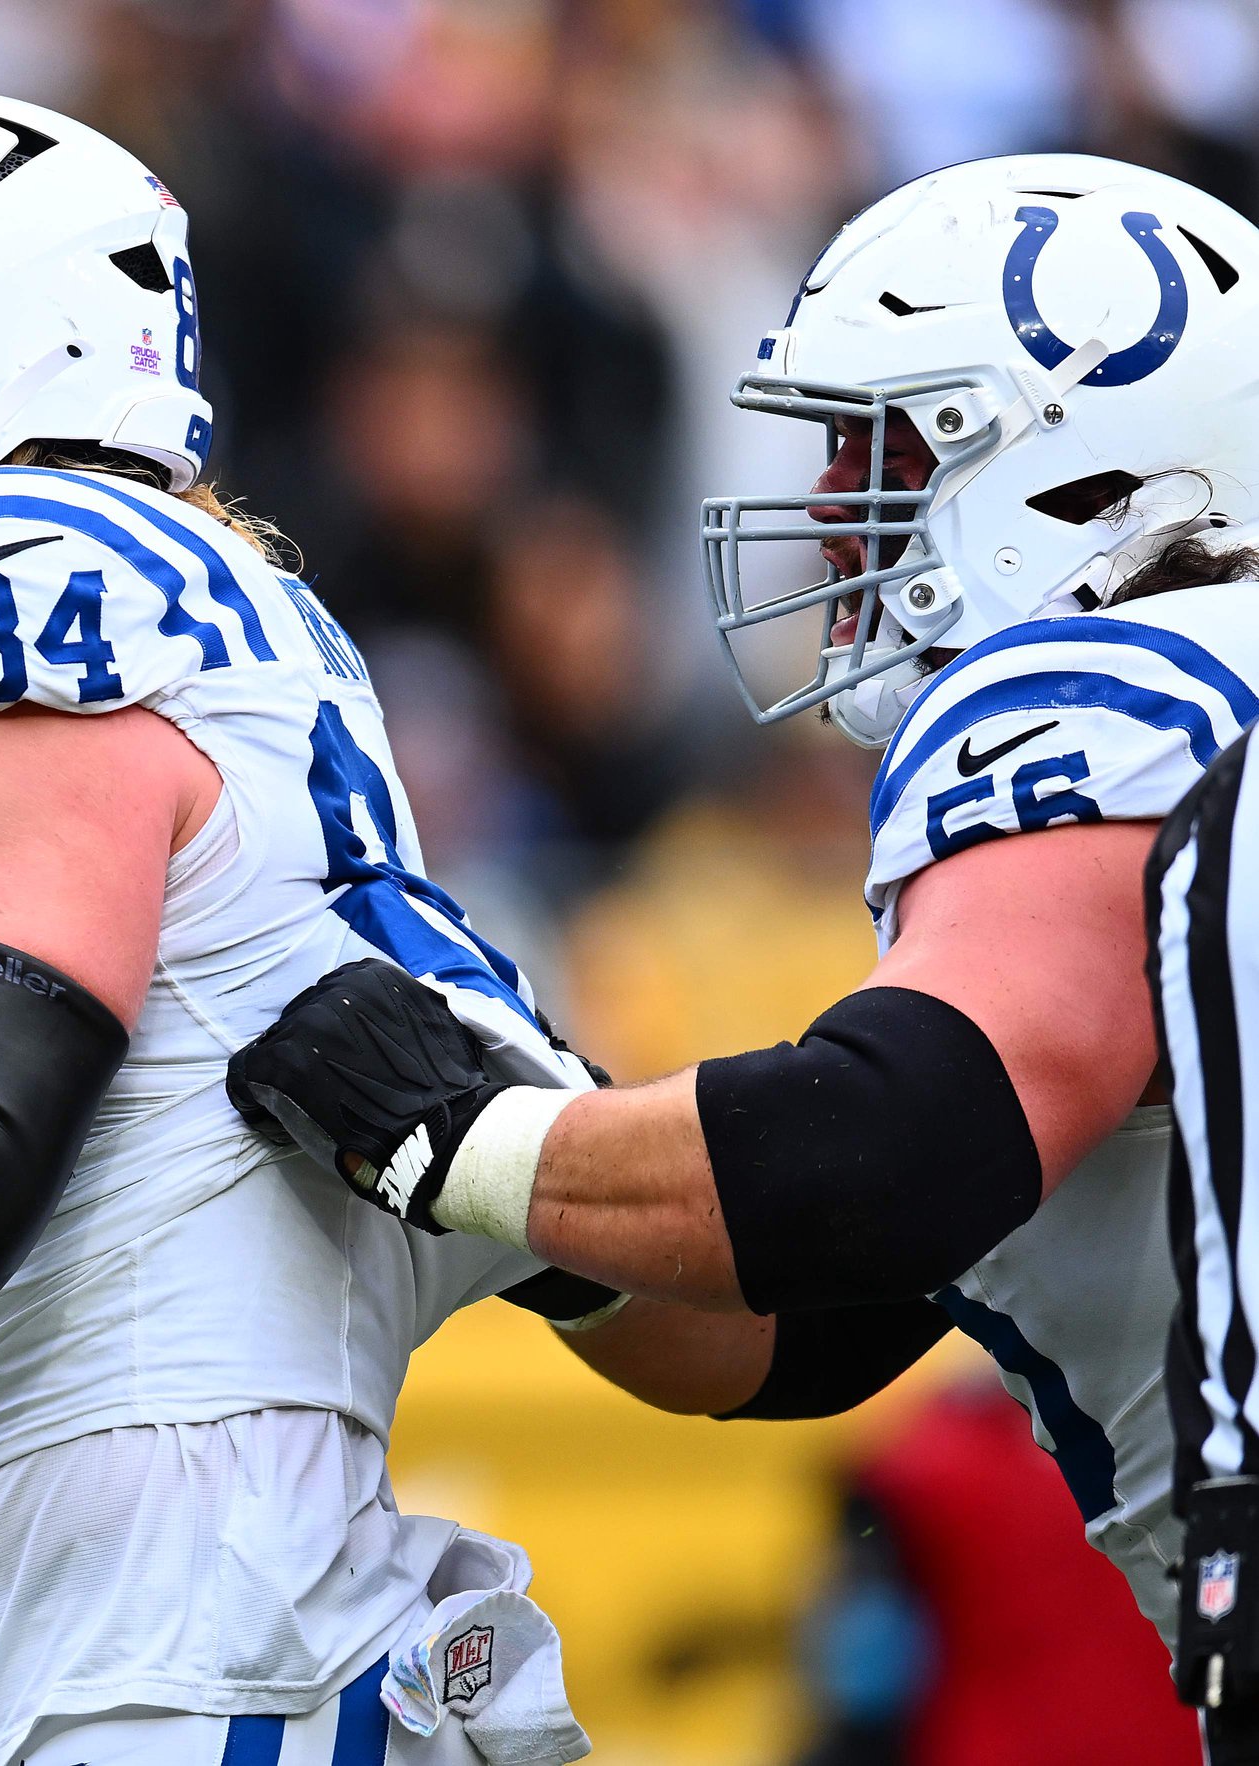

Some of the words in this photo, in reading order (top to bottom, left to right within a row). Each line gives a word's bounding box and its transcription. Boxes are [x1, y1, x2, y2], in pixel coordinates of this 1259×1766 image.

[131, 345, 161, 360] CRUCIAL
[134, 356, 158, 370] CATCH
[925, 749, 1104, 862] 56
[376, 1122, 435, 1219] NIKE
